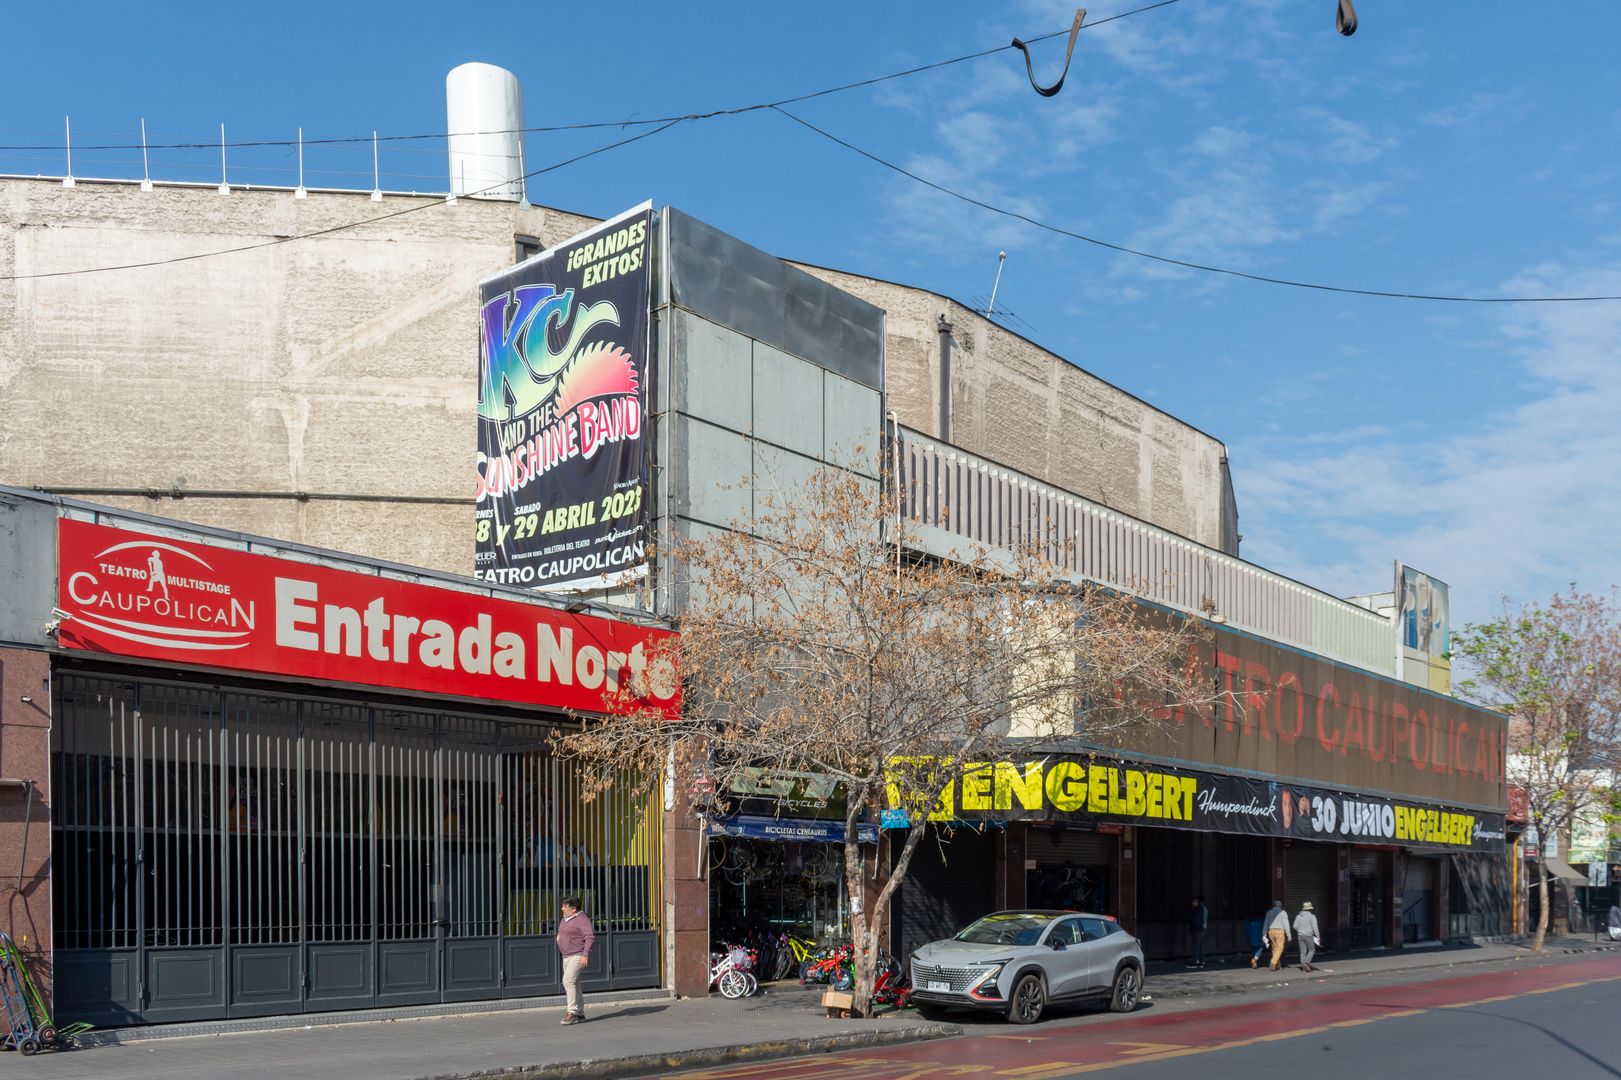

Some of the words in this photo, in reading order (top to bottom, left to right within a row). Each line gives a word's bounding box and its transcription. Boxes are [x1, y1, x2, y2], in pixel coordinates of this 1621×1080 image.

[567, 219, 647, 273] ¡GRANDES
[582, 244, 645, 289] EXITOS!
[478, 284, 621, 423] KC
[503, 419, 526, 451] AND
[528, 402, 553, 436] THE
[577, 396, 641, 460] BAND
[513, 513, 539, 540] 29
[541, 501, 596, 535] ABRIL
[600, 485, 642, 523] 2023
[514, 502, 541, 516] SABADO
[100, 563, 148, 580] TEATRO
[167, 576, 231, 595] MULTISTAGE
[537, 540, 645, 580] CAUPOLICAN
[68, 572, 255, 630] CAUPOLICAN
[275, 577, 526, 680] Entrada
[1316, 683, 1506, 785] CAUPOLICAN
[961, 761, 1197, 821] ENGELBERT
[1197, 787, 1278, 822] Humperdinck
[1311, 796, 1336, 833] 30
[1340, 801, 1395, 838] JUNIO
[1394, 806, 1475, 845] ENGELBERT
